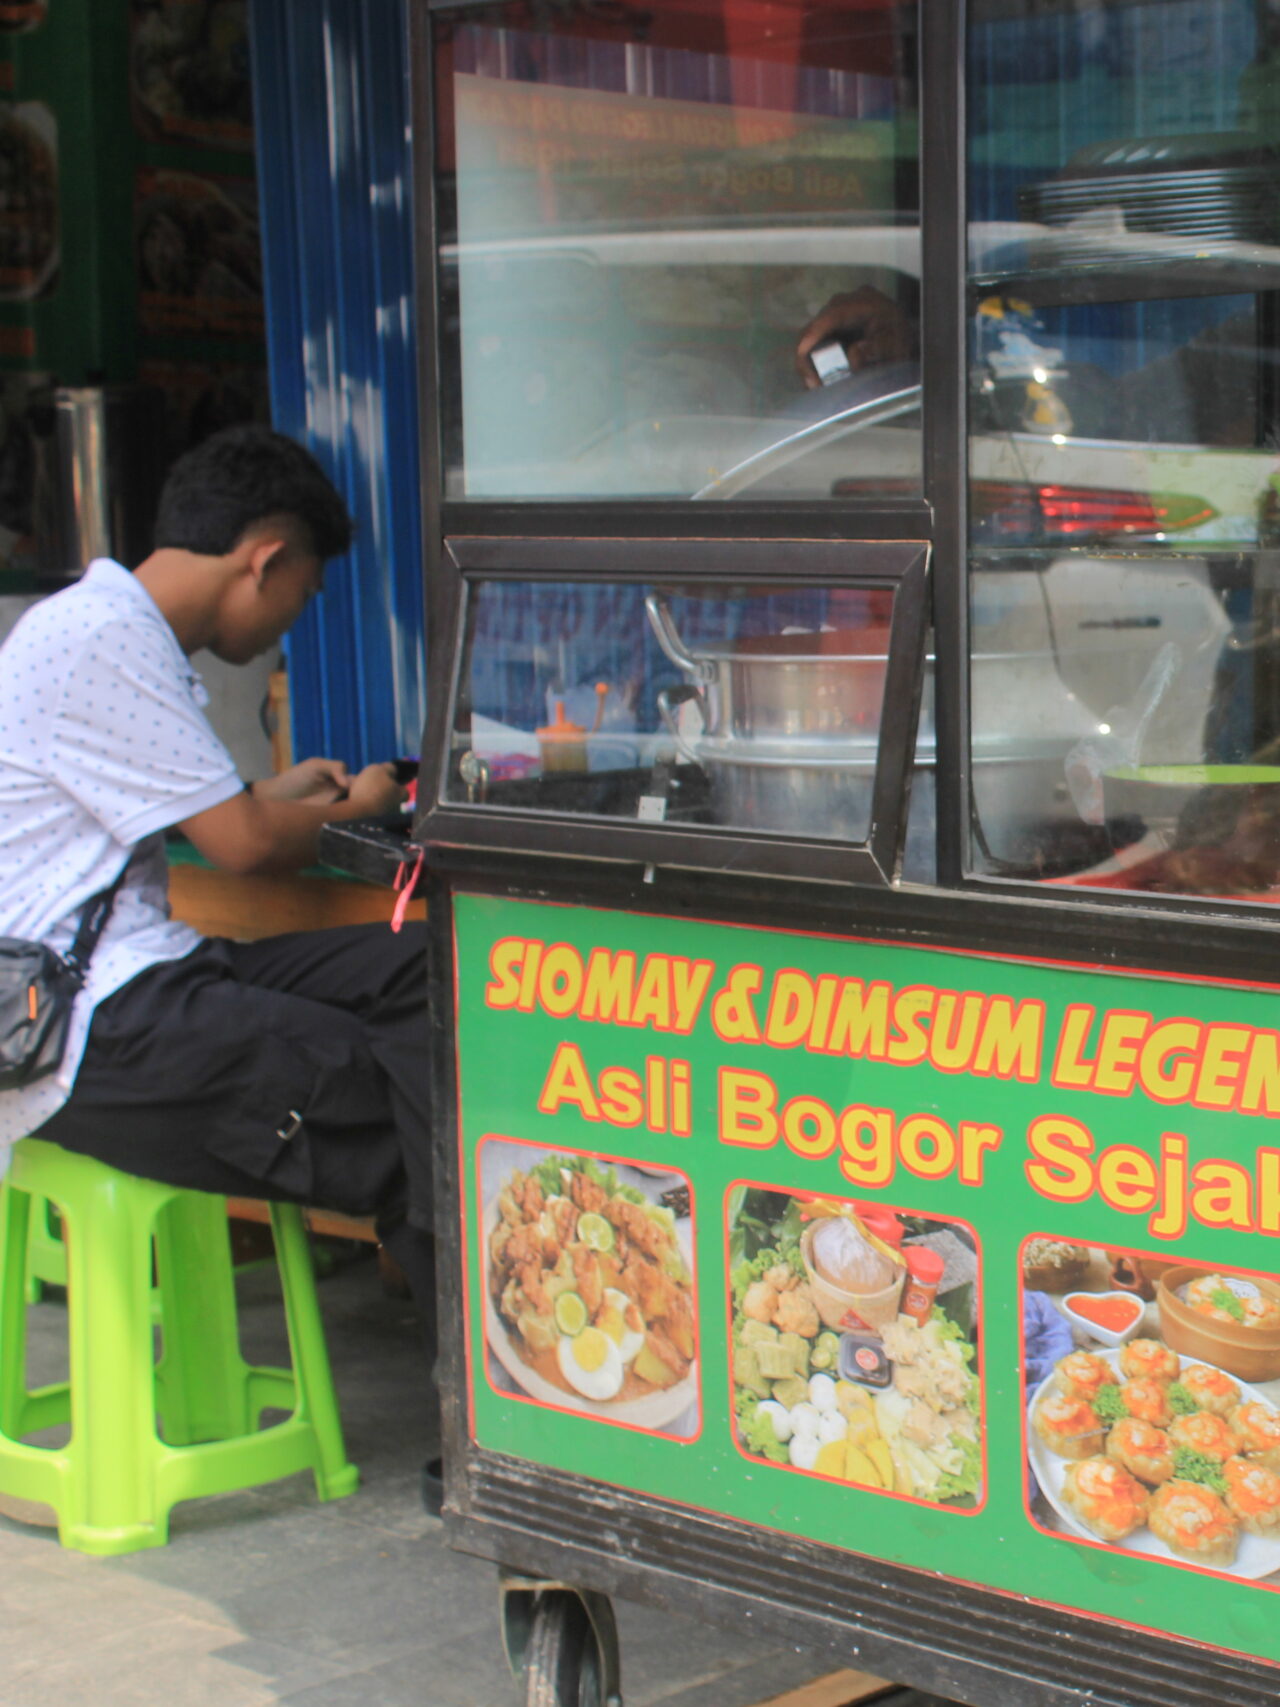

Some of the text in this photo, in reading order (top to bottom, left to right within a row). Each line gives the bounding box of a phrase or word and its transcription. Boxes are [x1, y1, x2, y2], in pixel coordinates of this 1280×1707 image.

[485, 936, 714, 1035] SIOMAY
[711, 962, 764, 1044] &
[764, 967, 1046, 1084] DIMSUM
[537, 1041, 692, 1138] Asli
[717, 1064, 1003, 1188] Bogor
